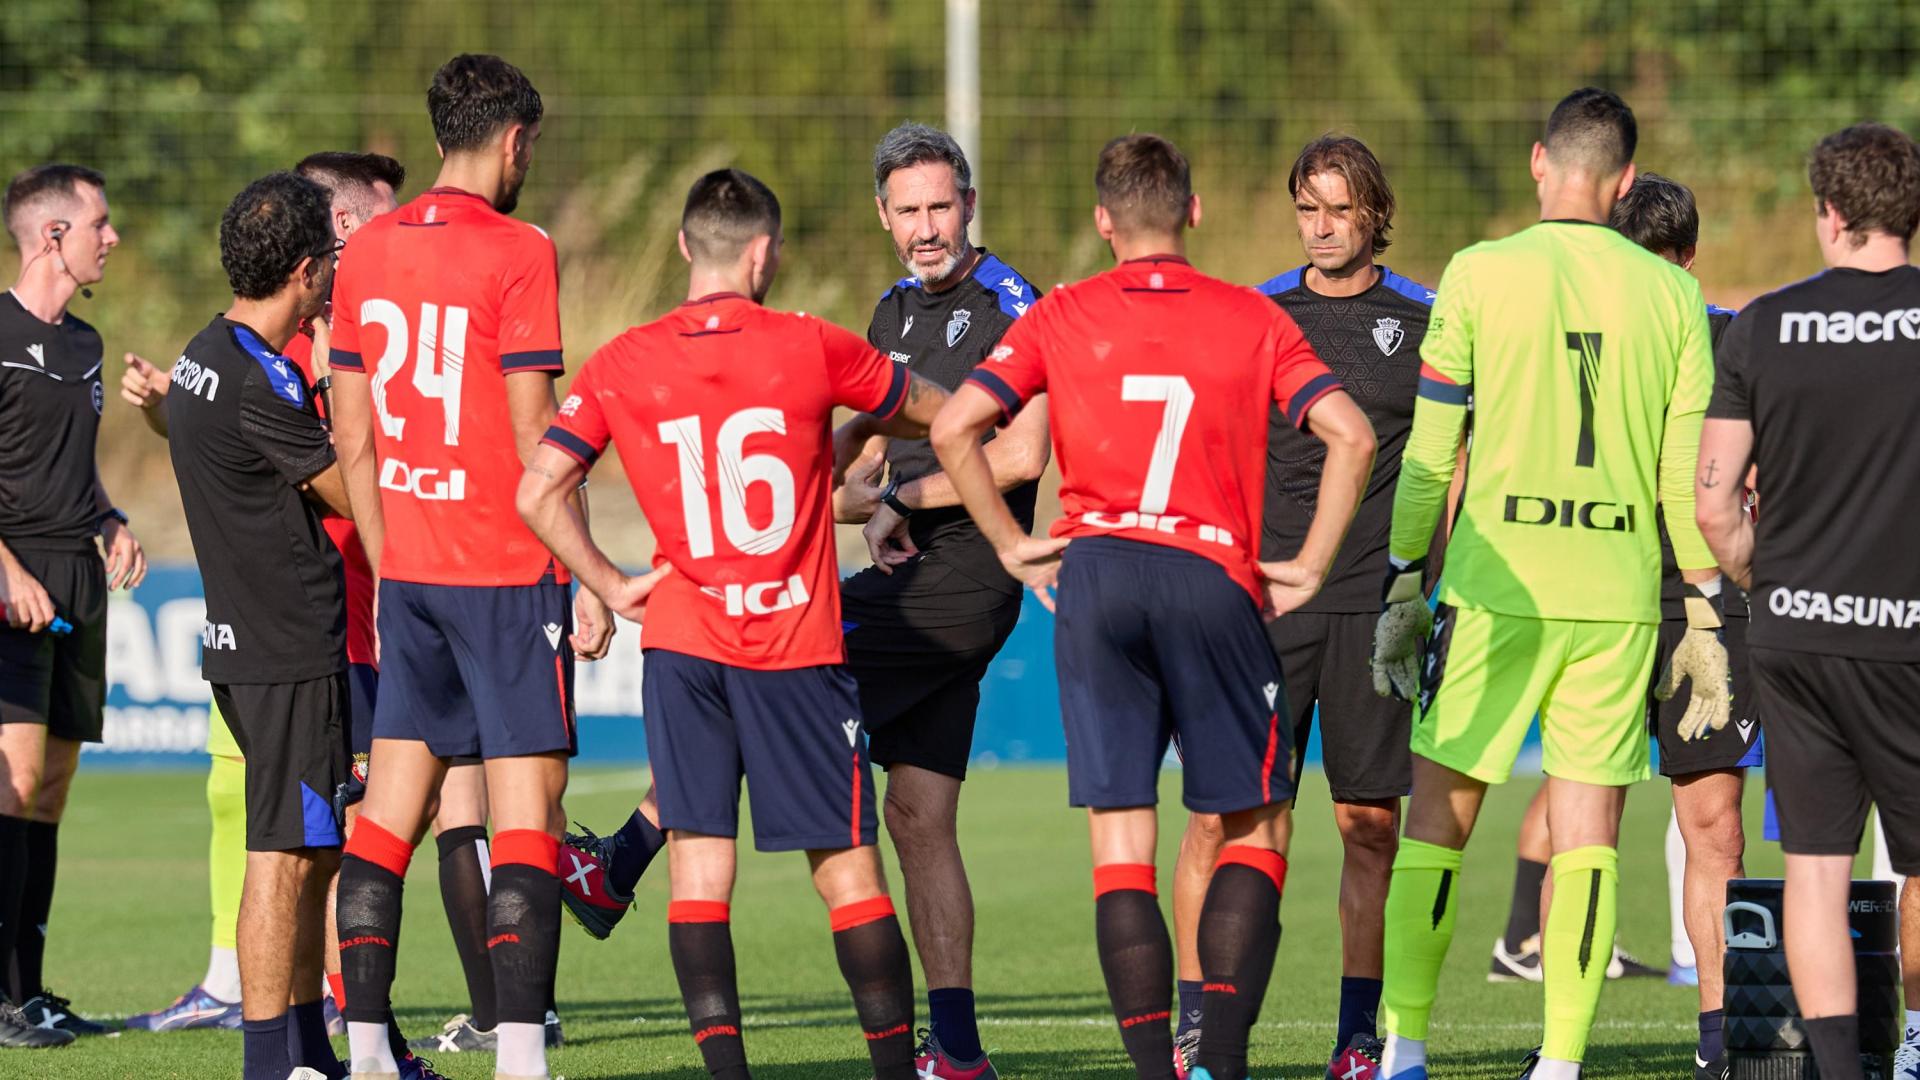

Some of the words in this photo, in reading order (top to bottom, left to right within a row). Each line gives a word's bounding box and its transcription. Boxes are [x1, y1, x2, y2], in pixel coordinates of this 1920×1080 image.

[1779, 308, 1920, 343] macro
[172, 355, 219, 401] acron
[361, 298, 468, 446] 24
[1121, 374, 1196, 514] 7
[379, 457, 466, 500] DGI
[658, 406, 795, 560] 16
[1503, 495, 1635, 533] DIGI
[700, 574, 810, 616] IGI
[1768, 586, 1920, 629] OSASUNA
